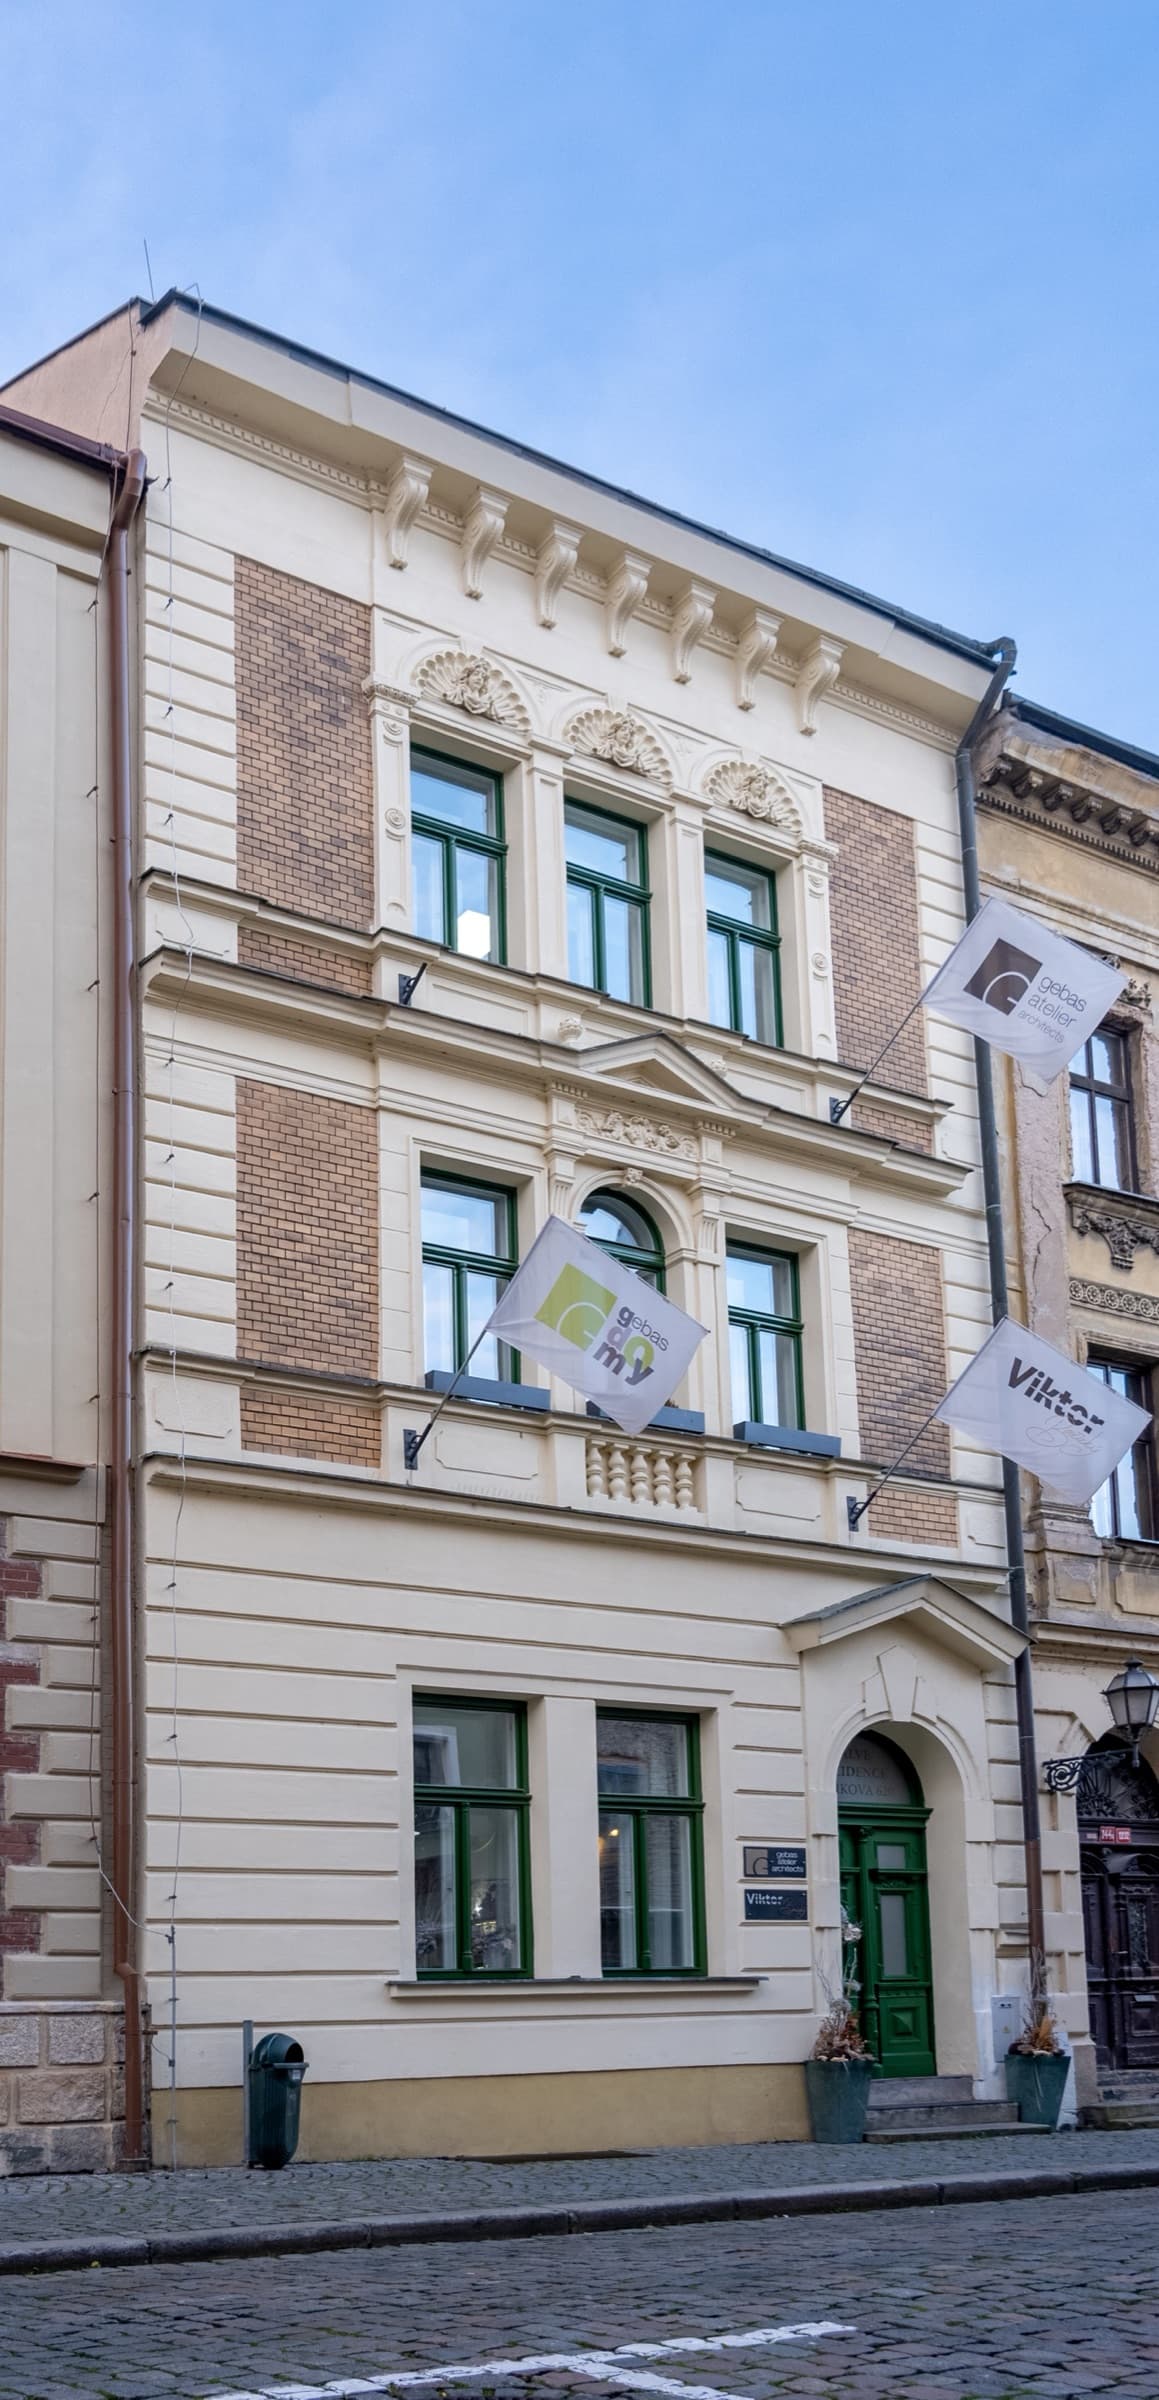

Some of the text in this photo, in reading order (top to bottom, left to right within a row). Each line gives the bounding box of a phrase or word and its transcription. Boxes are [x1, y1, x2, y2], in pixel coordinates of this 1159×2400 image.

[1027, 994, 1078, 1028] atelier
[1038, 976, 1087, 1012] gebas
[1017, 1009, 1065, 1044] architects
[616, 1306, 669, 1352] gebas
[1007, 1356, 1105, 1435] Viktor
[746, 1892, 784, 1905] Viktor
